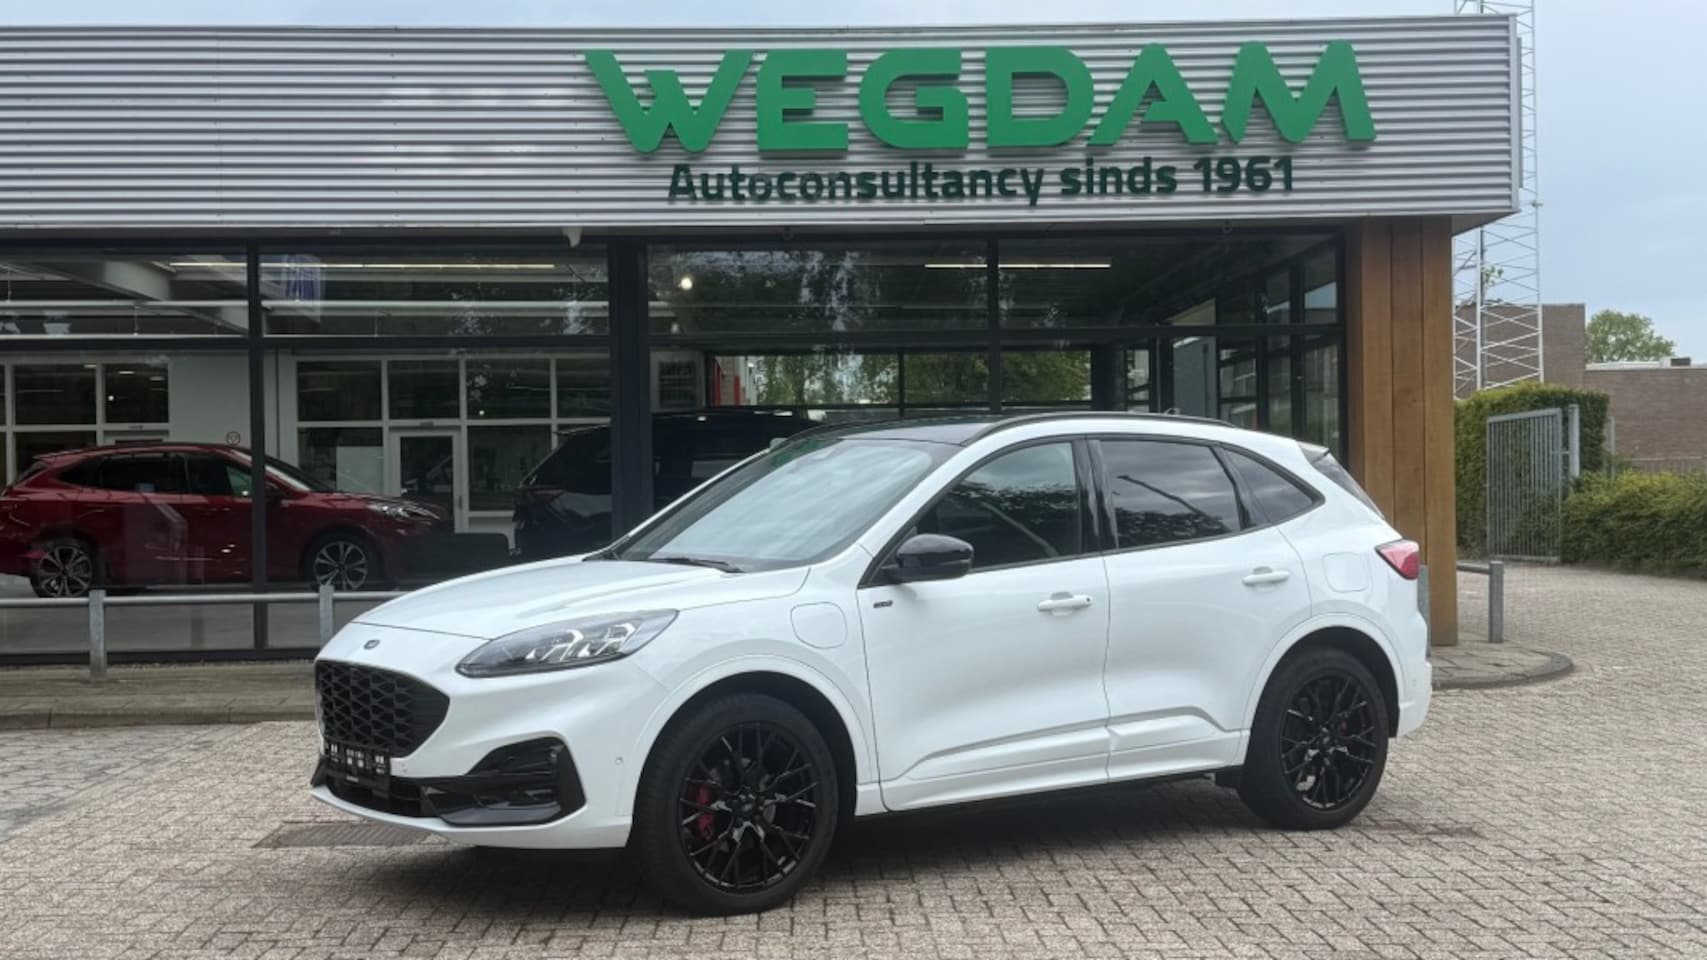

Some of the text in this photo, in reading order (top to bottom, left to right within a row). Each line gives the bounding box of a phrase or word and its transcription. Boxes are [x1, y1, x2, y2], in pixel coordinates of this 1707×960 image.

[585, 41, 1376, 152] WEGDAM
[669, 155, 1294, 206] Autoconsultancy sinds 1961
